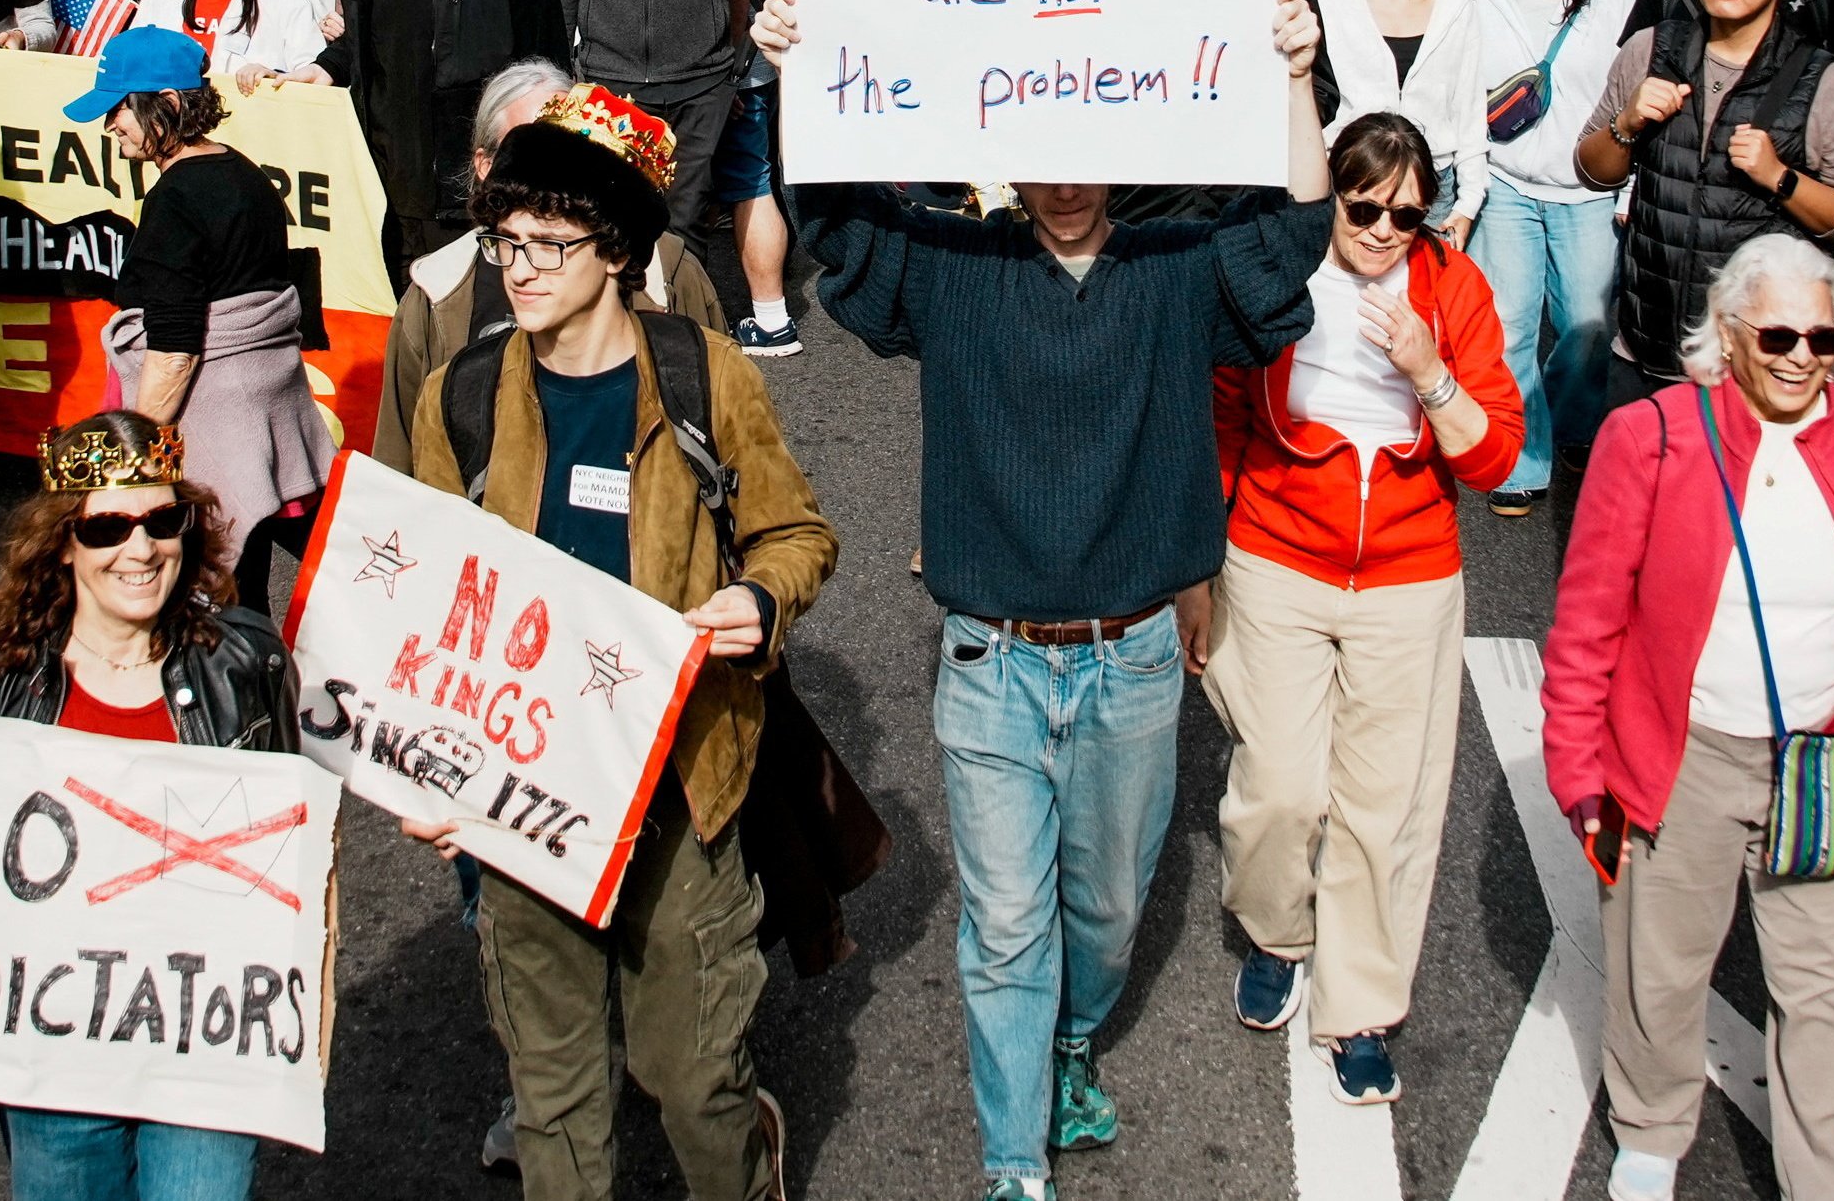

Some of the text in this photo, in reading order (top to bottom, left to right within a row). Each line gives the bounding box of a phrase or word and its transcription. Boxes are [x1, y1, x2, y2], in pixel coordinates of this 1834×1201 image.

[827, 46, 921, 114] the
[575, 468, 630, 483] NYC NEIGHB
[578, 494, 605, 507] VOTE
[437, 554, 551, 673] NO
[385, 633, 554, 765] KINGS
[487, 771, 591, 859] 1776
